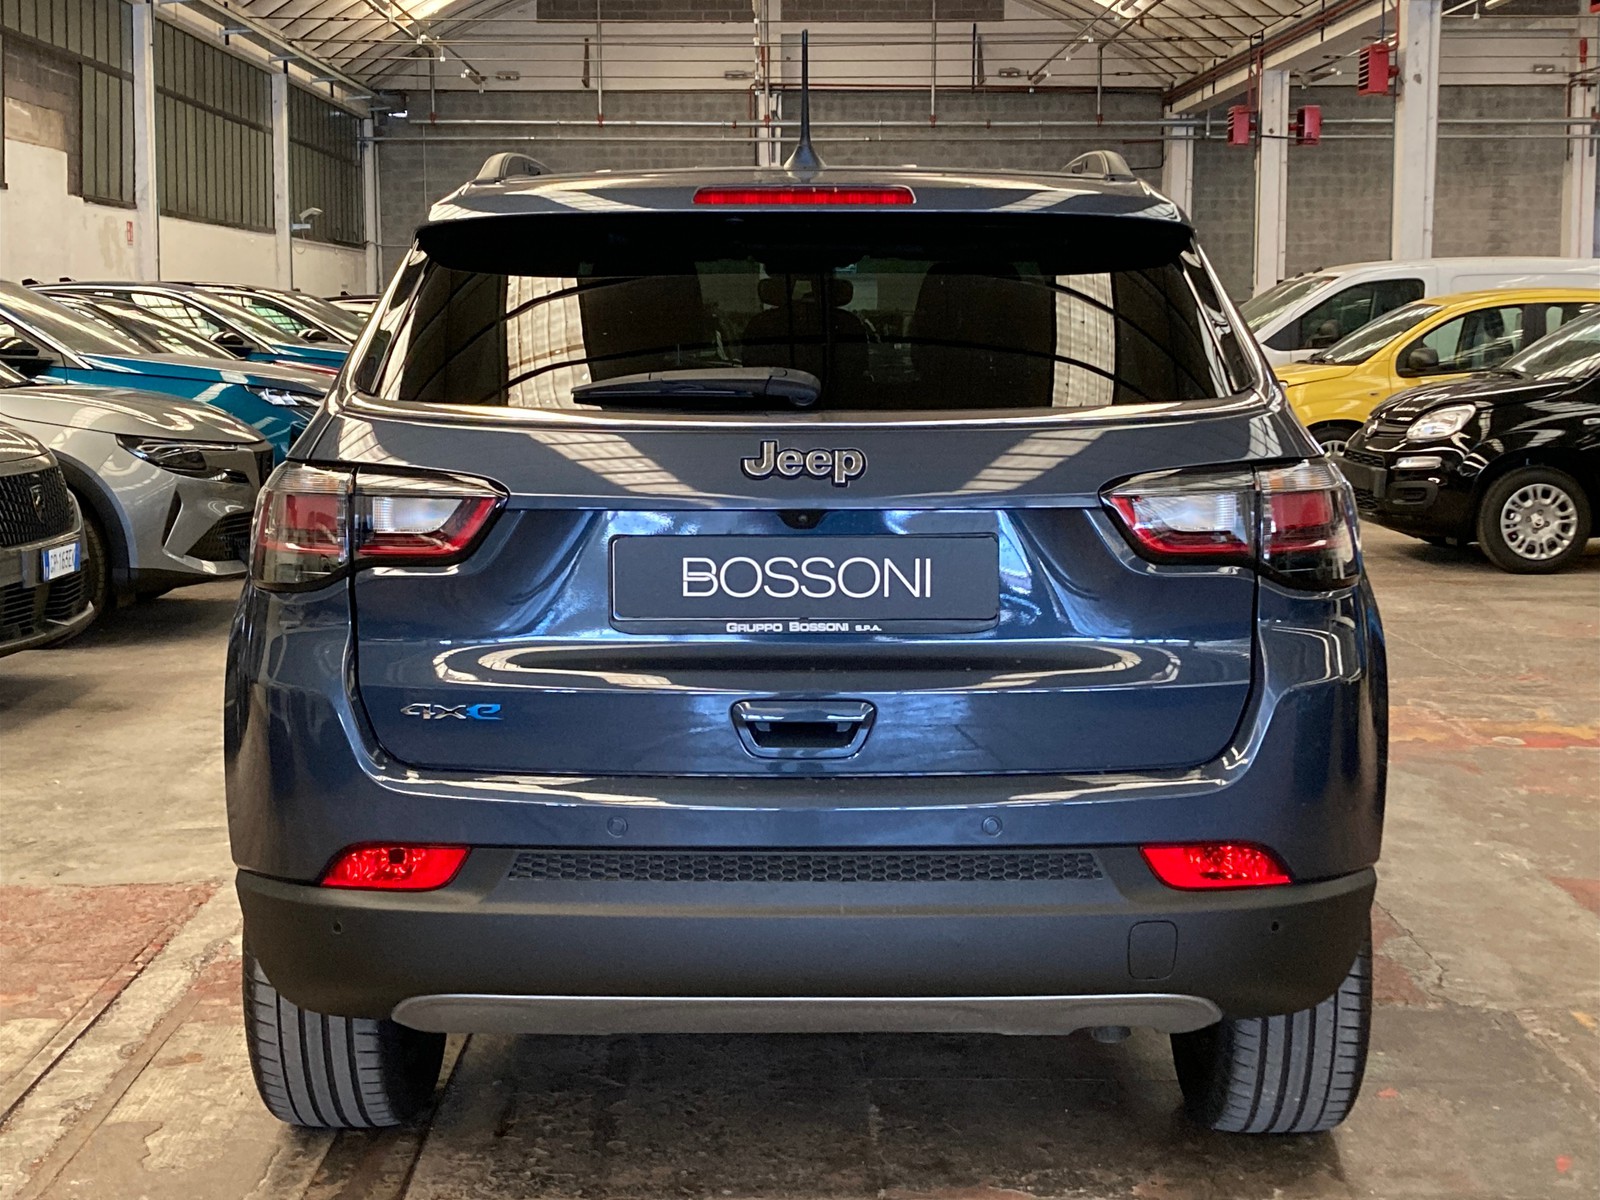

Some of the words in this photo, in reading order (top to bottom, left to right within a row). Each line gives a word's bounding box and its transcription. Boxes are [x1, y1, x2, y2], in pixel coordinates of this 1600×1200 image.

[742, 440, 866, 486] Jeep
[682, 556, 932, 598] BOSSONI
[726, 622, 783, 633] GRUPPO
[789, 621, 849, 632] BOSSONI
